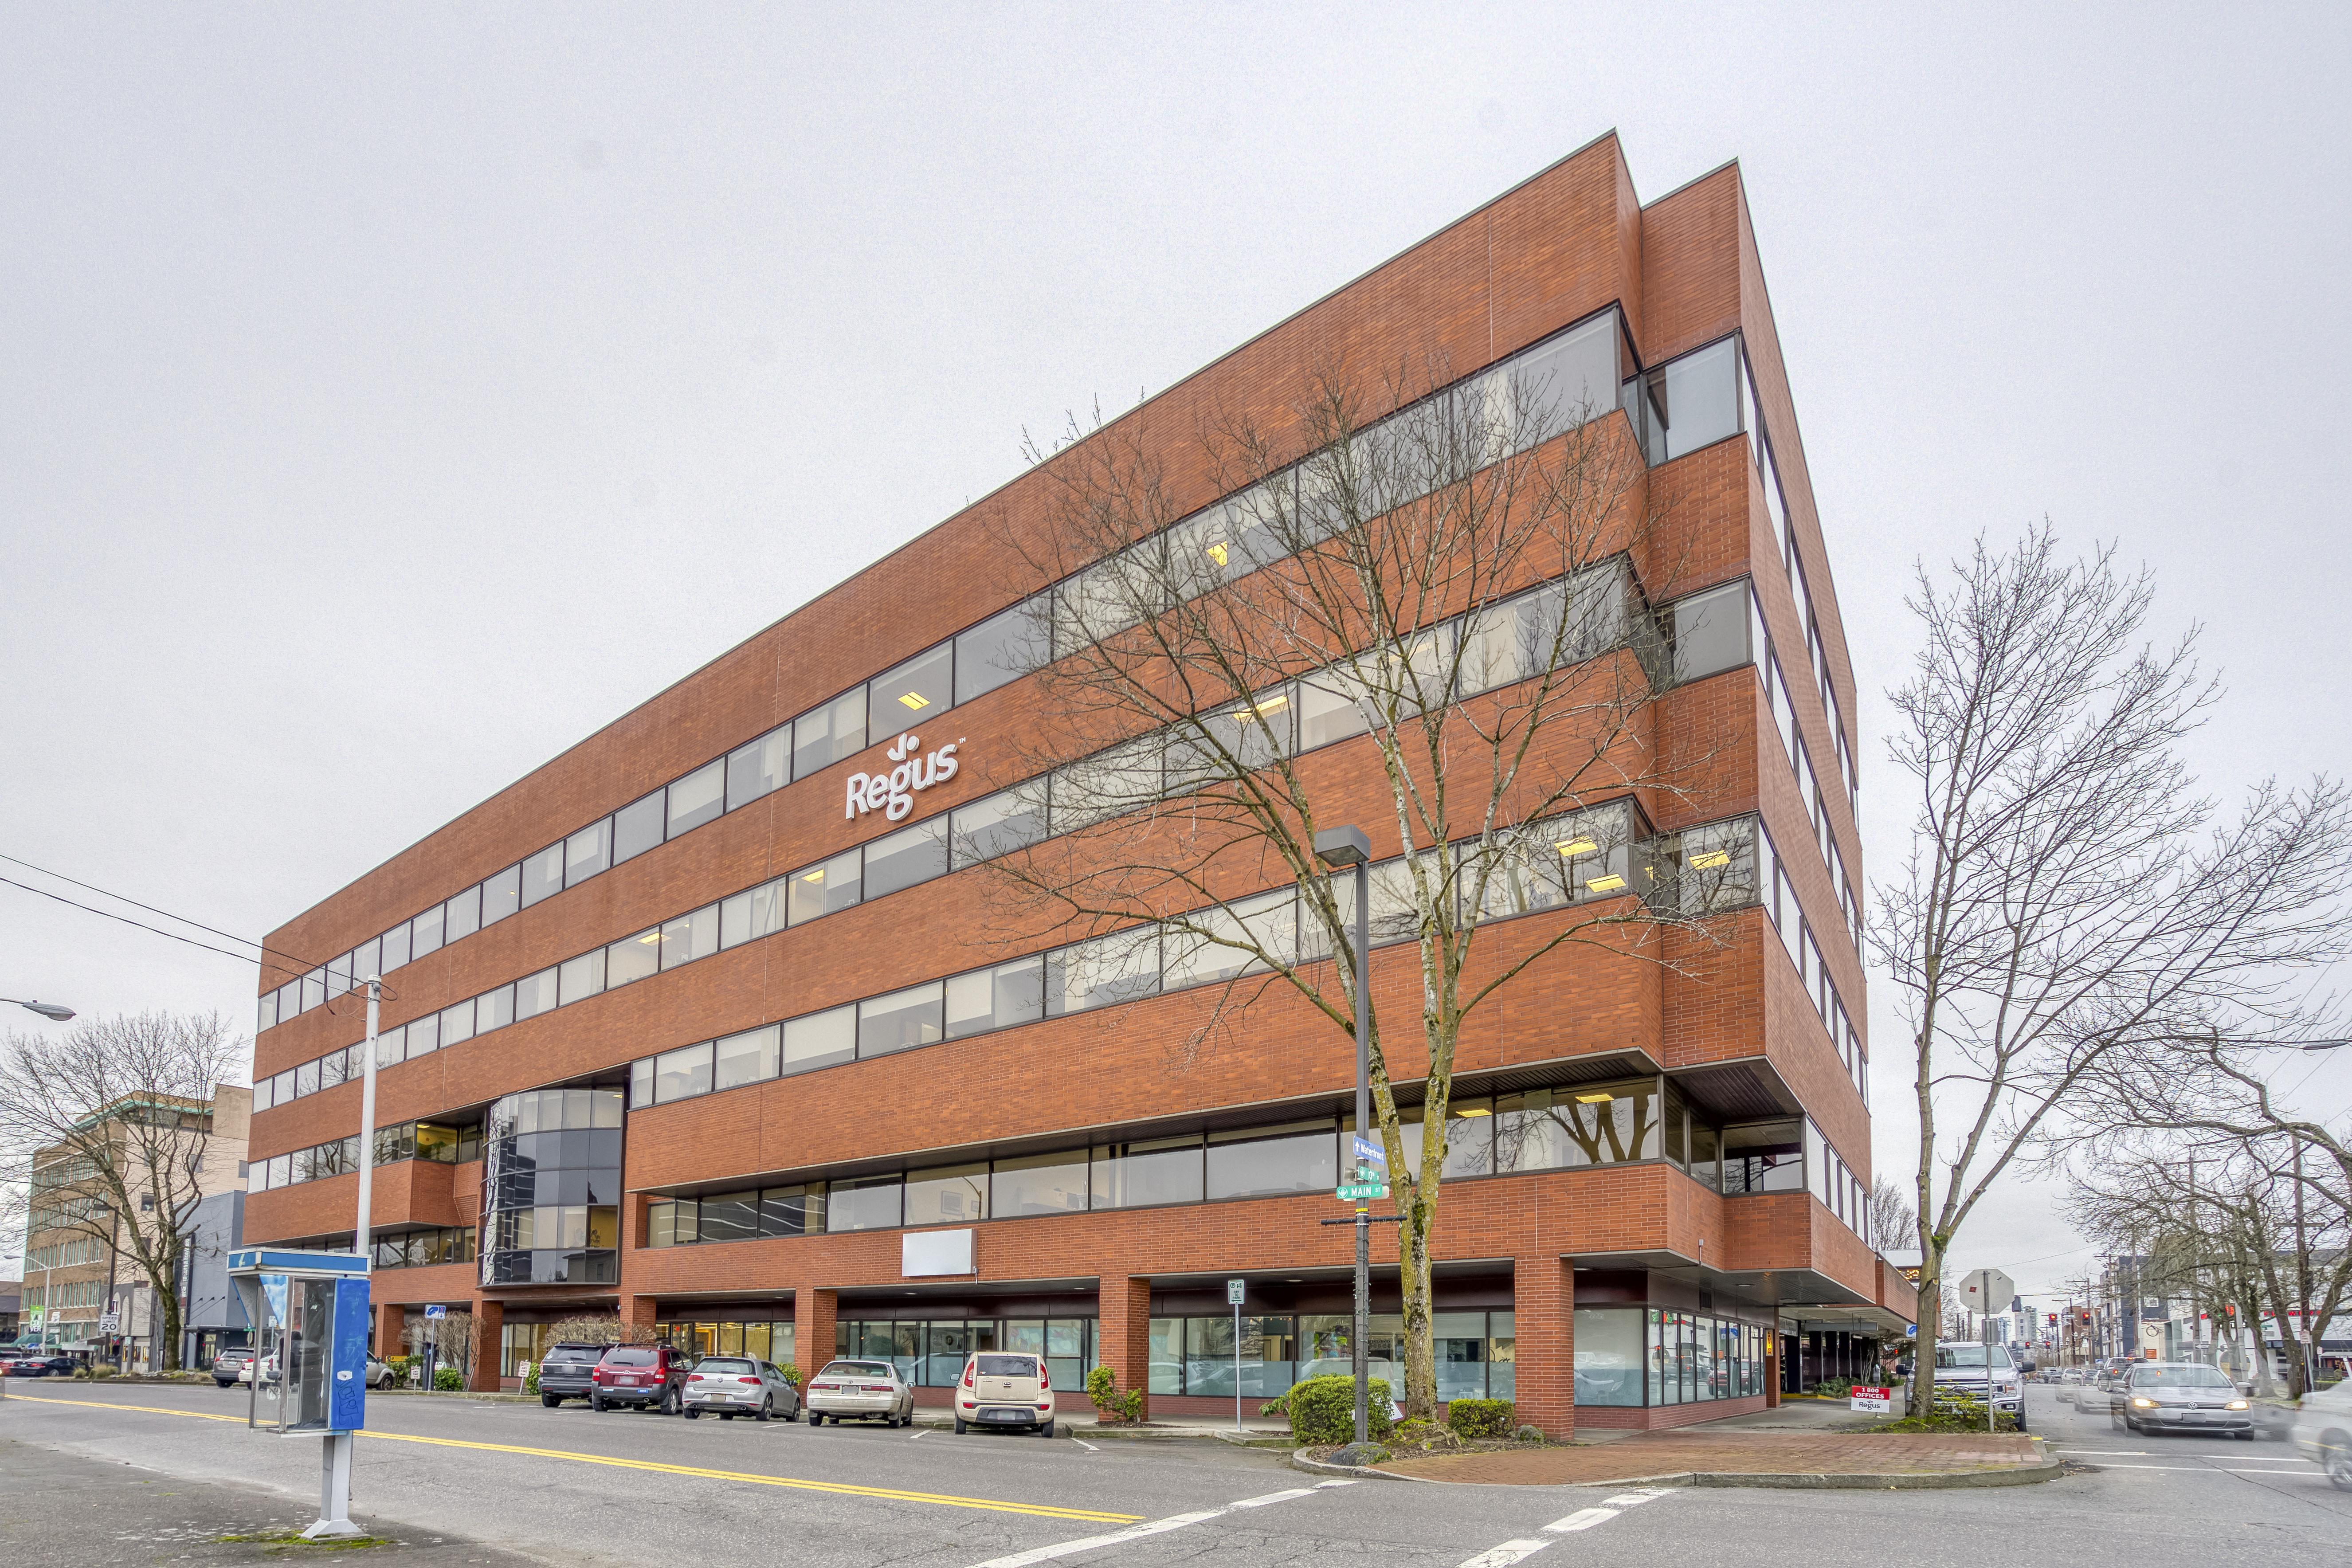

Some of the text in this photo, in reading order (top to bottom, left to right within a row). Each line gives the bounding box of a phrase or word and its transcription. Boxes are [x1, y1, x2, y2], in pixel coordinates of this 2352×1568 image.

[846, 744, 959, 821] Regus
[1360, 1143, 1384, 1160] Waterfront
[1351, 1187, 1371, 1196] MAIN
[1859, 1401, 1881, 1410] Regus
